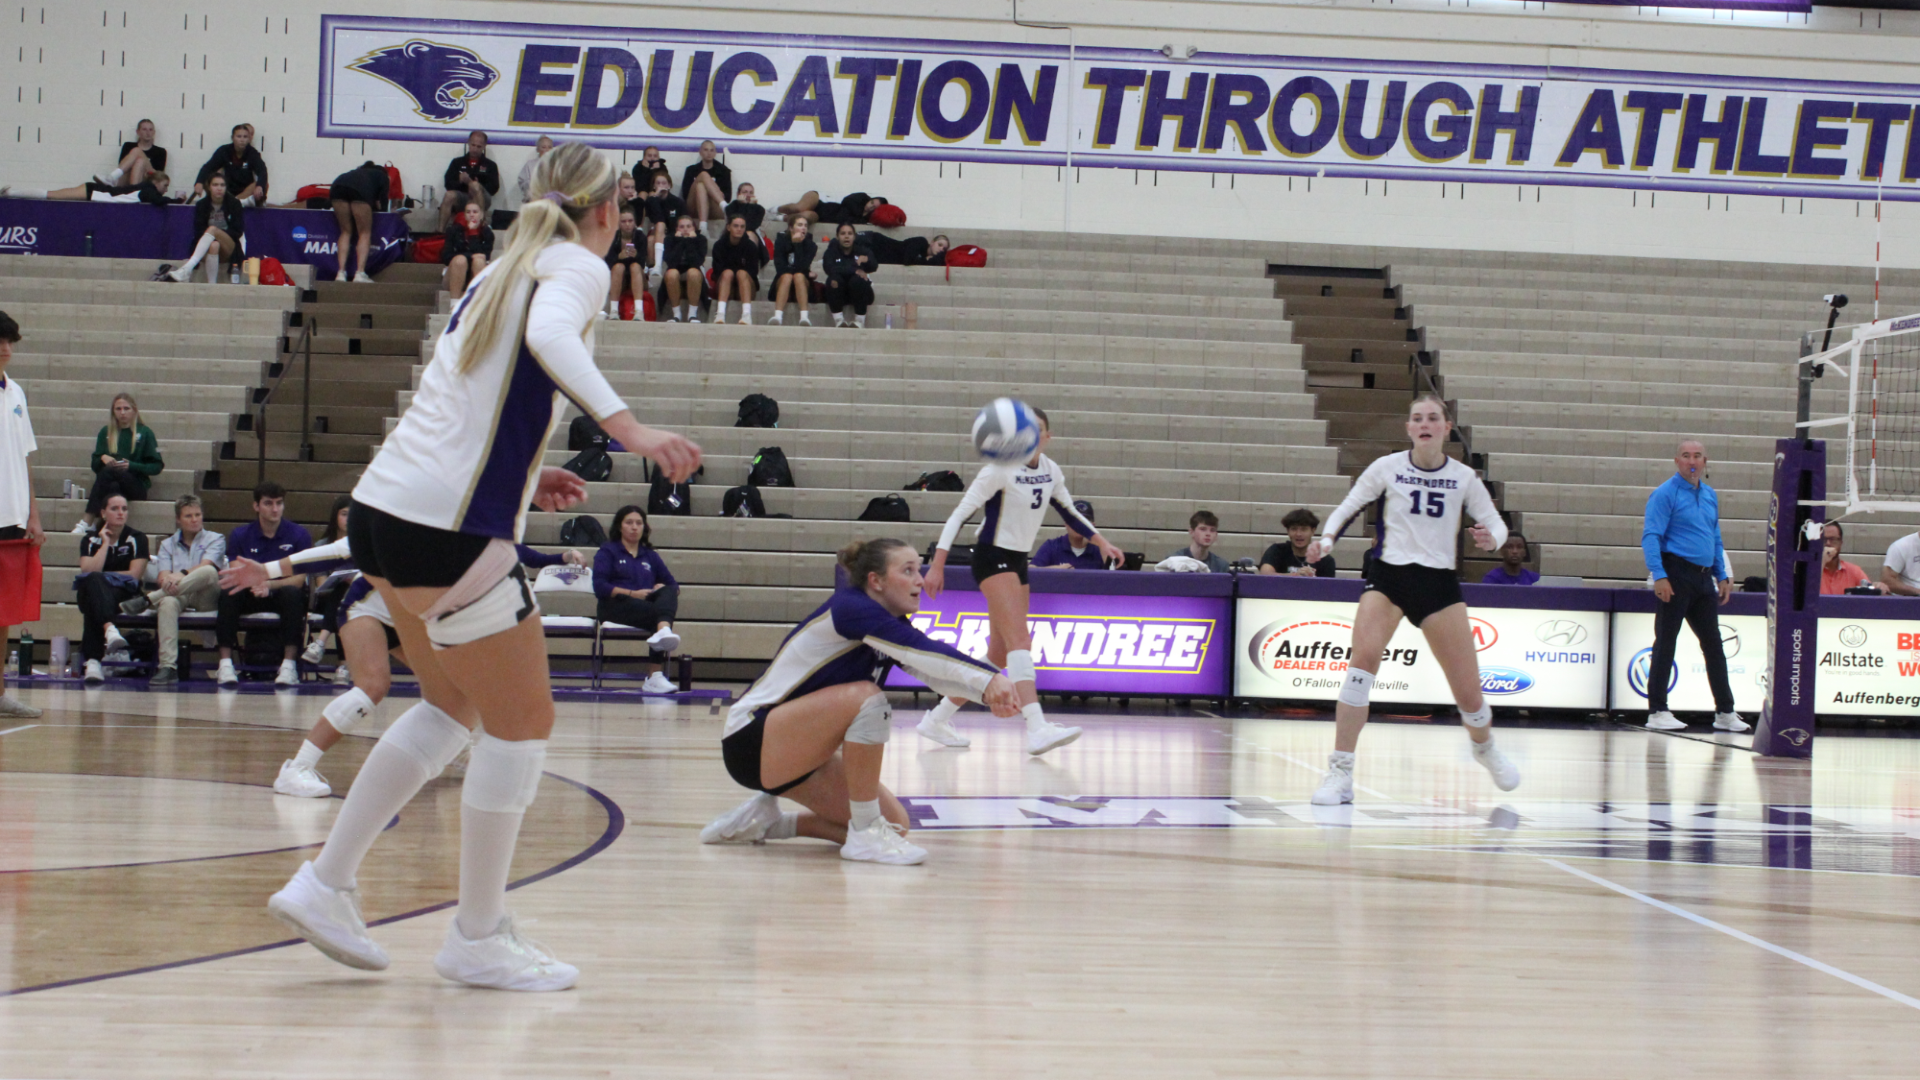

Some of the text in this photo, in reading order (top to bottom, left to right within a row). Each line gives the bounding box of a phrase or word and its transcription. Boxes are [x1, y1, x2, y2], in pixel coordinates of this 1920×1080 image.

[508, 43, 1059, 146] EDUCATION
[1083, 66, 1541, 166] THROUGH
[1031, 488, 1043, 510] 3
[1409, 489, 1446, 518] 15
[1275, 640, 1418, 666] Auffeerg
[1525, 651, 1596, 664] HYUNDAI
[1819, 652, 1884, 668] Allstate
[1273, 660, 1326, 671] DEALER
[1789, 628, 1802, 706] sports imports
[1371, 680, 1409, 691] lleville
[1833, 691, 1920, 708] Auffenberg
